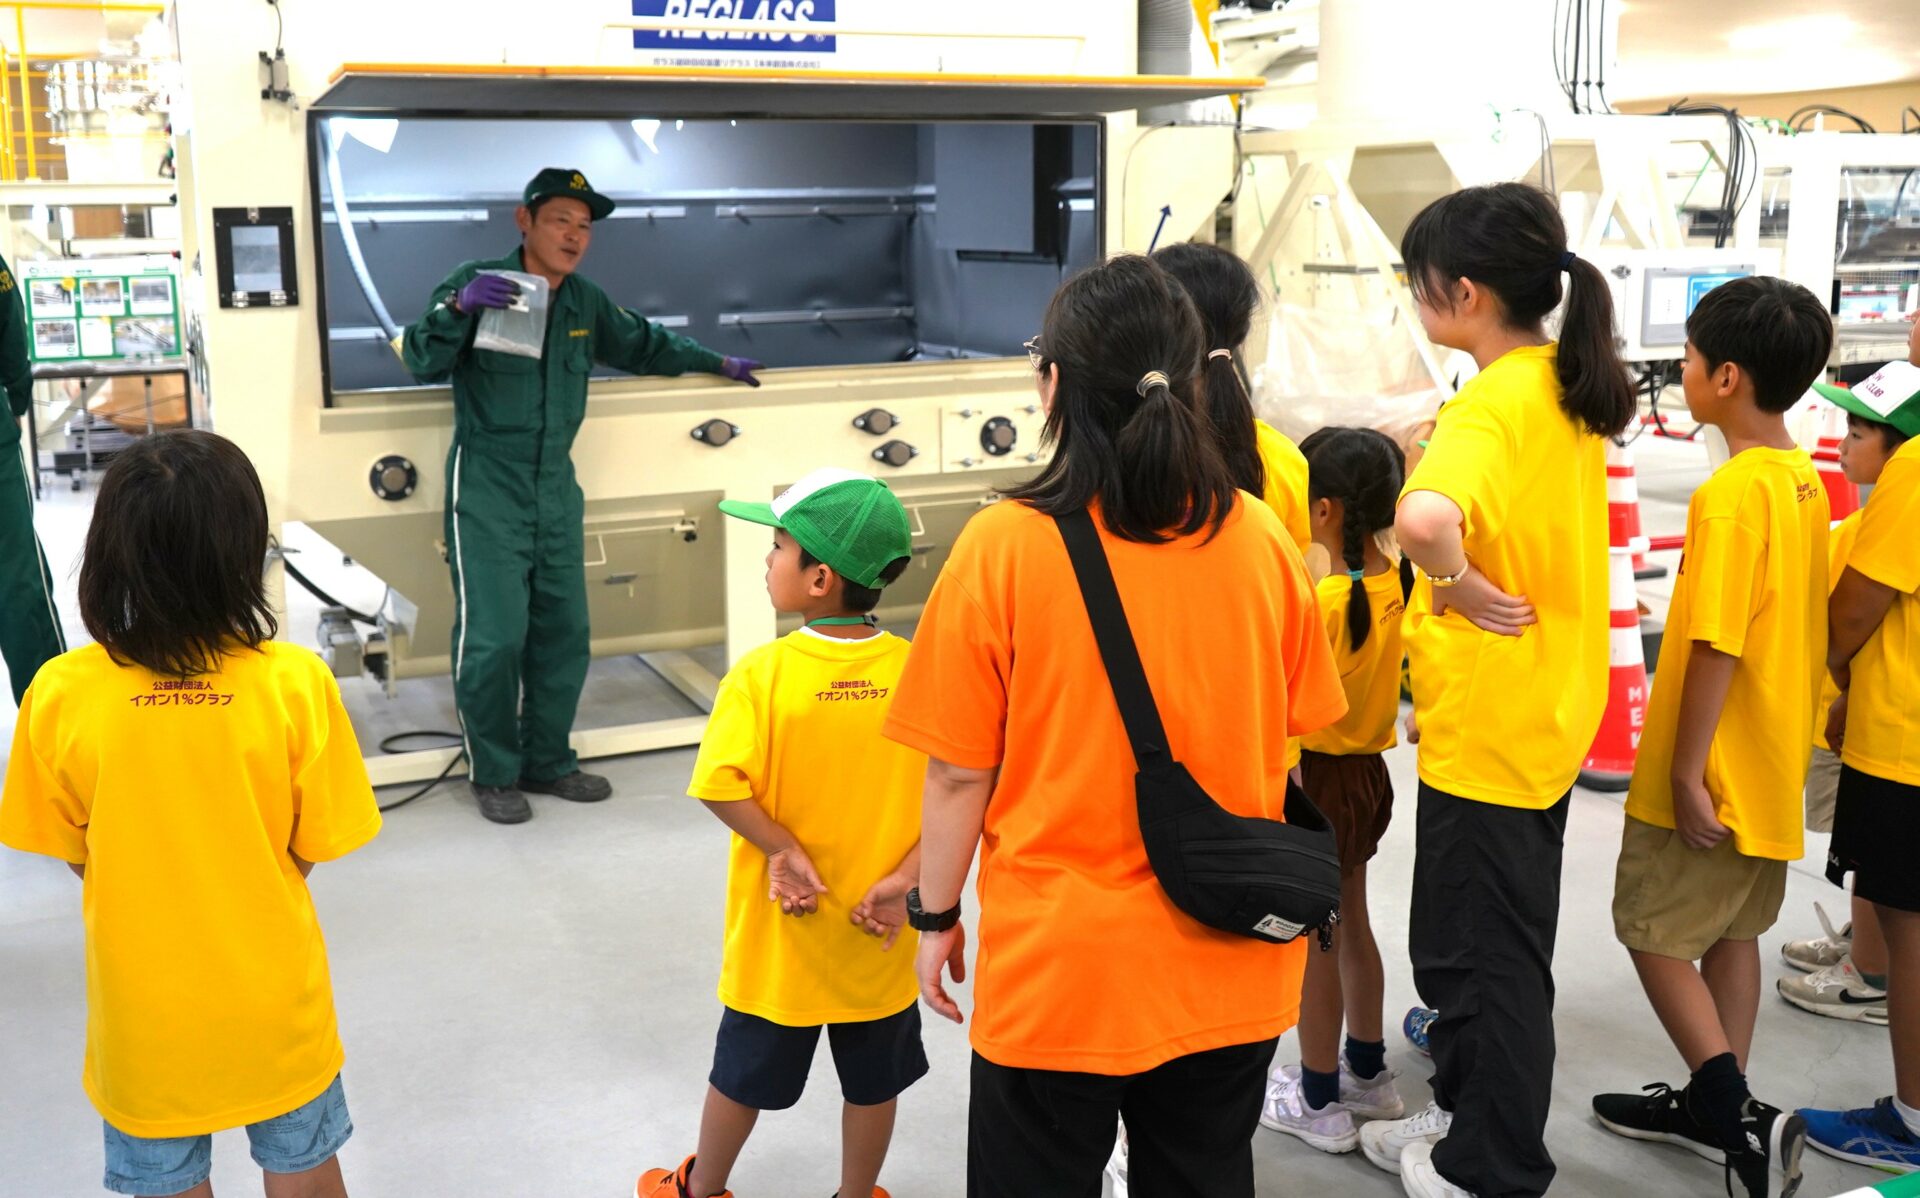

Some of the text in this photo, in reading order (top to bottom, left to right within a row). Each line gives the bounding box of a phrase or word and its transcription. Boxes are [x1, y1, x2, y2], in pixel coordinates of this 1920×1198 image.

[658, 0, 815, 42] REGLASS
[153, 681, 213, 691] 公益財団法人
[830, 680, 874, 689] 公益財団法人
[130, 693, 234, 706] イオン1%クラブ
[815, 688, 889, 701] イオン1%クラブ
